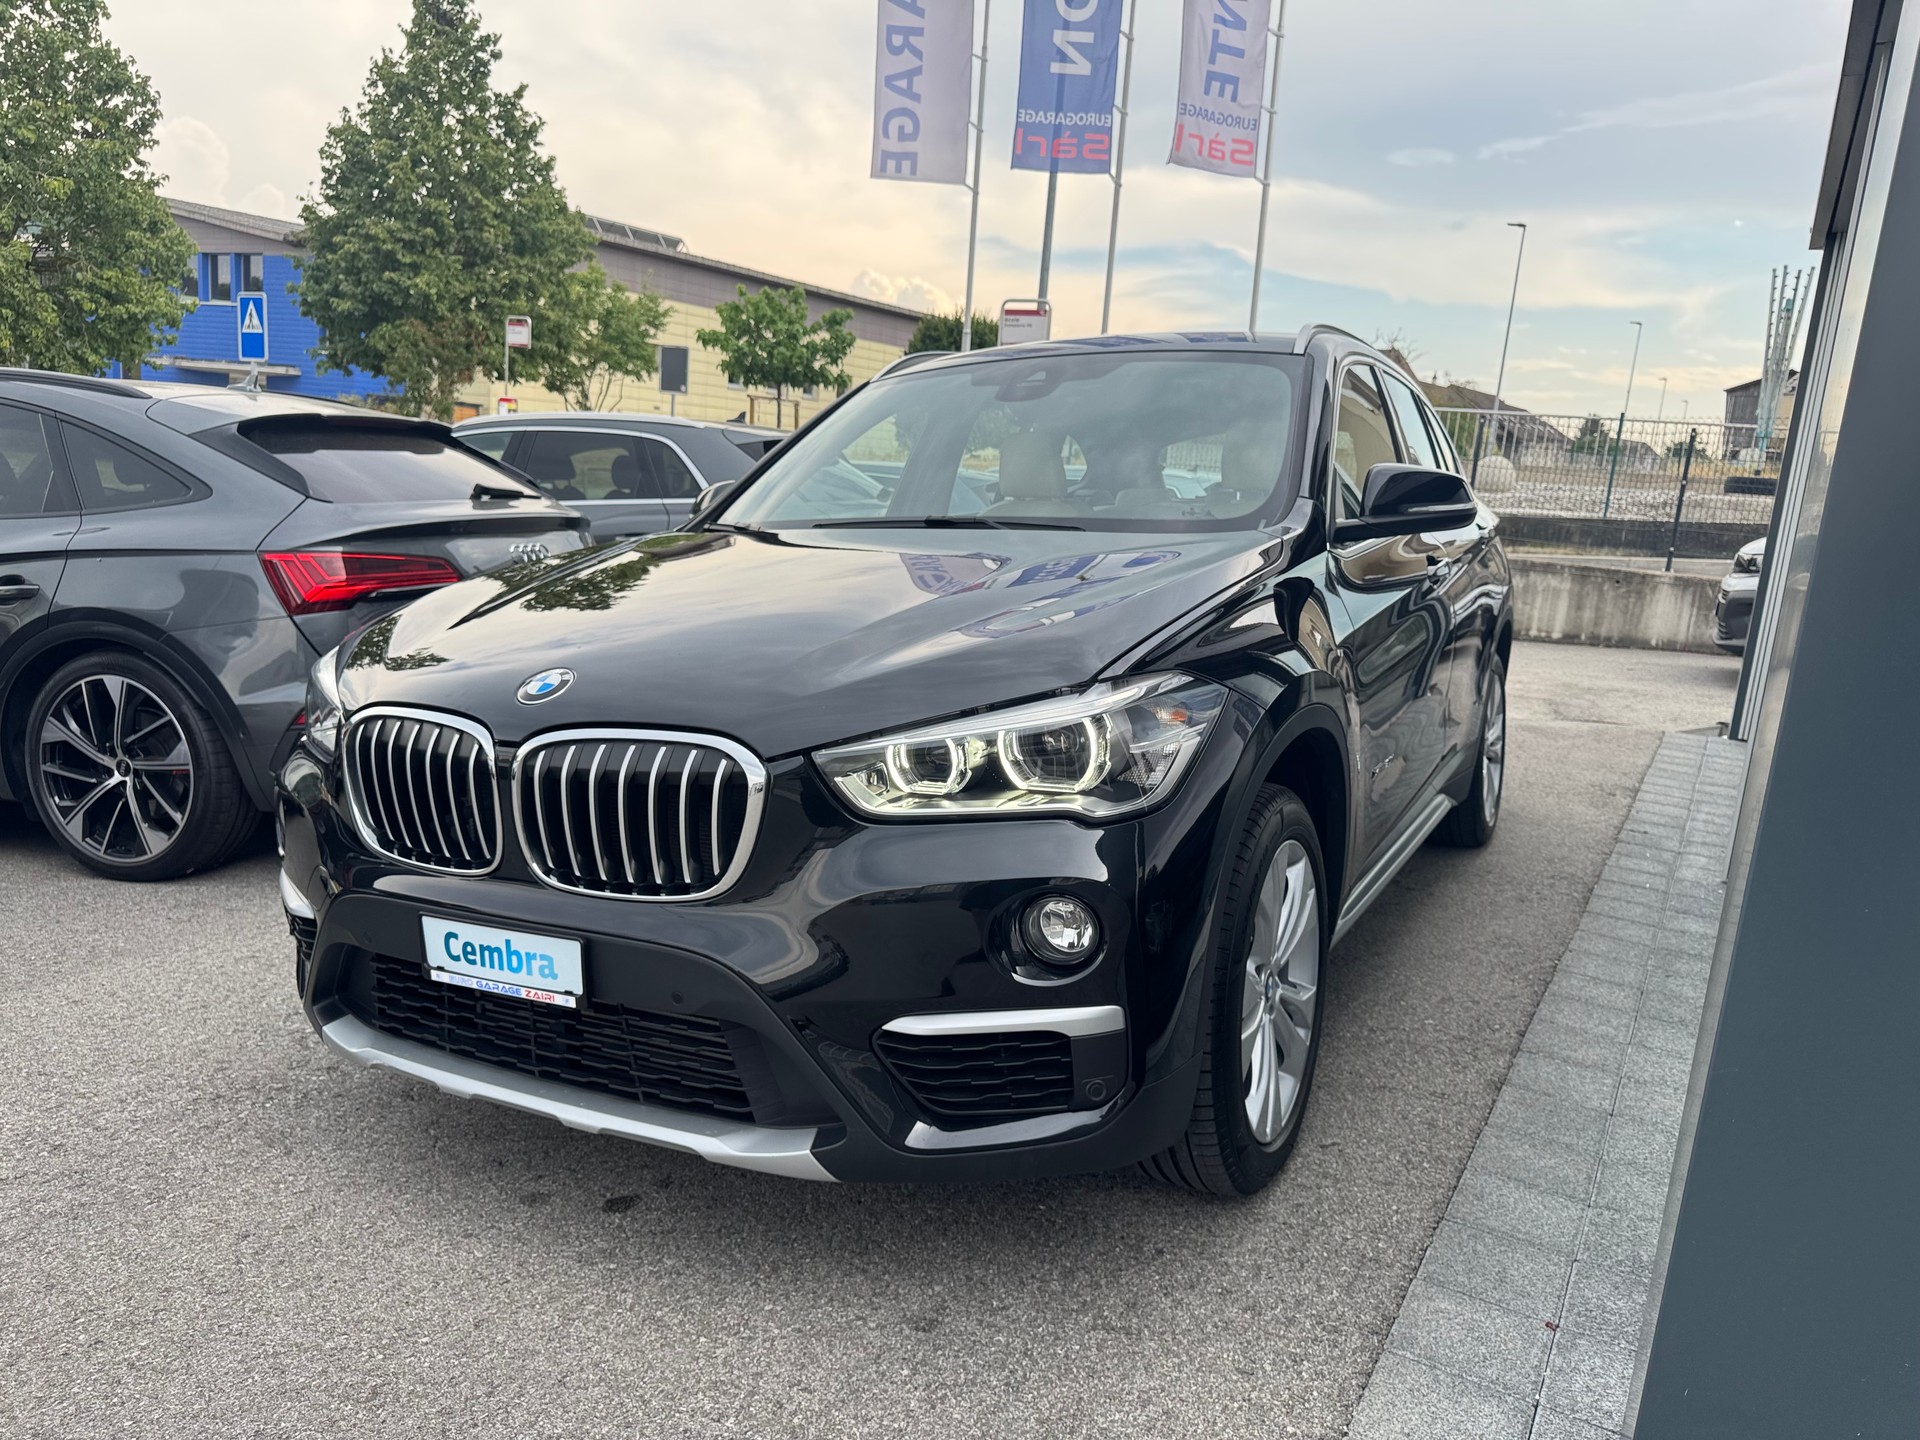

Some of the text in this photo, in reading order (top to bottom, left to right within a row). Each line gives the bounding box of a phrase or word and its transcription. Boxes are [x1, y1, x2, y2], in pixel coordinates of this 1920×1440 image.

[444, 931, 558, 981] Cembra
[475, 980, 522, 996] GARAGE
[524, 989, 556, 1003] ZAIRI
